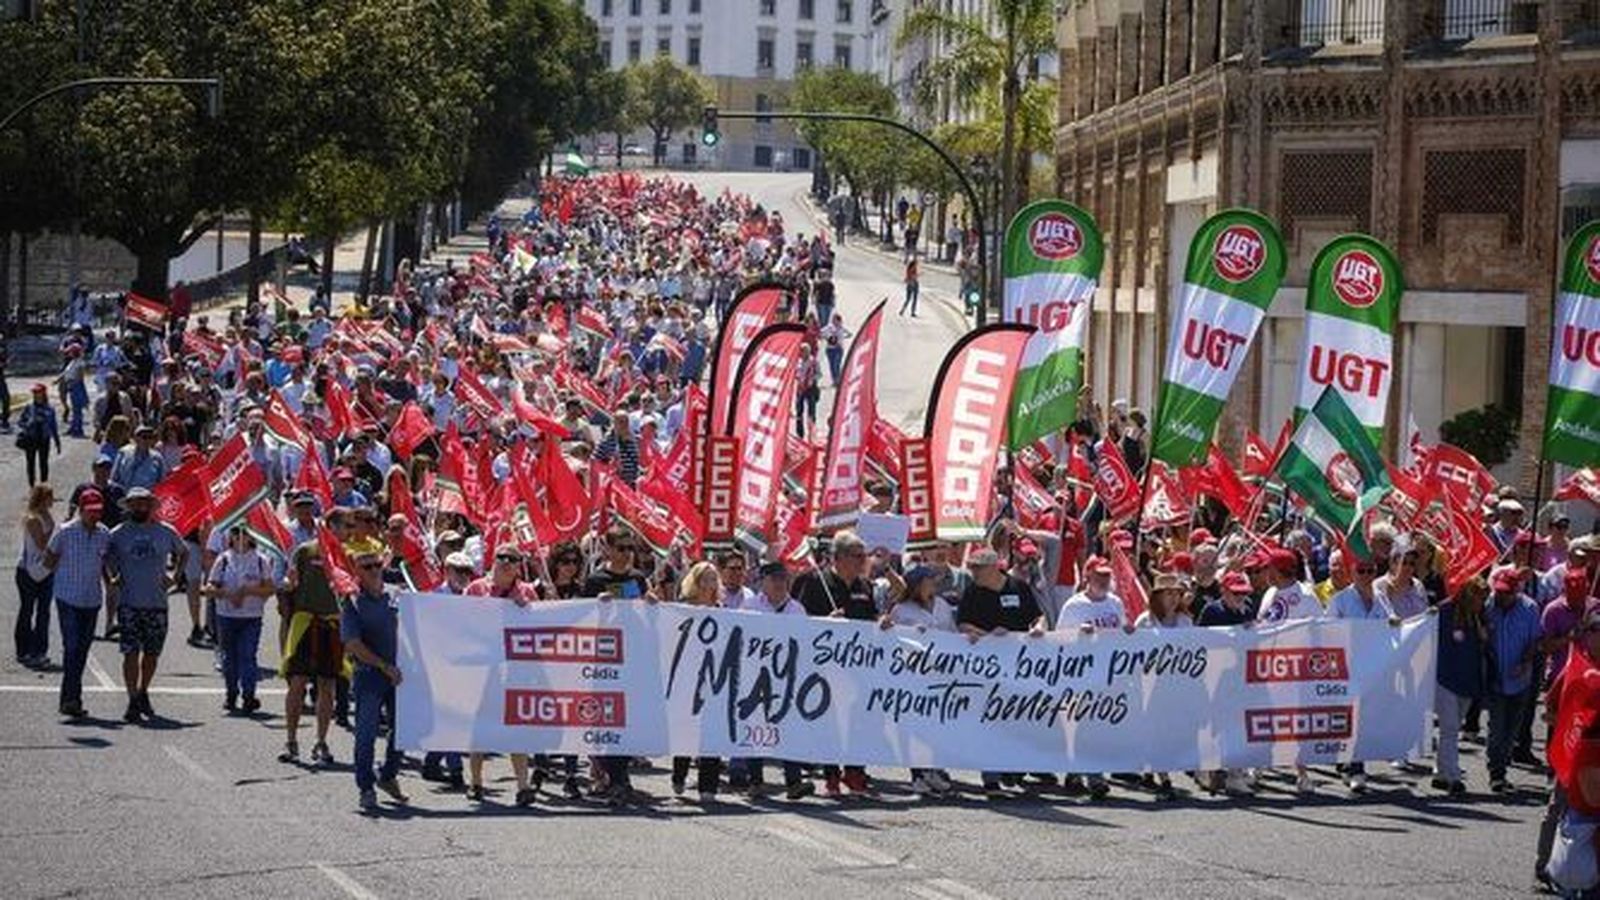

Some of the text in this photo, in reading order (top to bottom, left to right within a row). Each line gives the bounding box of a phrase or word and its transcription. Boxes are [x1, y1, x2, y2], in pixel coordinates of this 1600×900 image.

[1035, 219, 1077, 249] UGT
[1220, 230, 1260, 260] UGT
[1340, 257, 1378, 287] UGT
[1183, 318, 1247, 371] UGT
[1309, 345, 1389, 398] UGT
[942, 348, 1007, 502] CCOO
[709, 441, 734, 533] CCOO
[904, 442, 930, 534] CCOO
[511, 632, 595, 655] CCOO
[748, 637, 774, 659] DE
[813, 630, 884, 669] Subir
[1016, 646, 1094, 687] bajar
[1107, 643, 1208, 679] precios
[581, 664, 620, 680] Cádiz
[1256, 654, 1302, 679] UGT
[692, 625, 832, 744] MAYO
[517, 697, 573, 721] UGT
[867, 682, 1129, 727] repartir beneficios
[583, 729, 621, 745] Cádiz
[1251, 713, 1330, 736] CCOO
